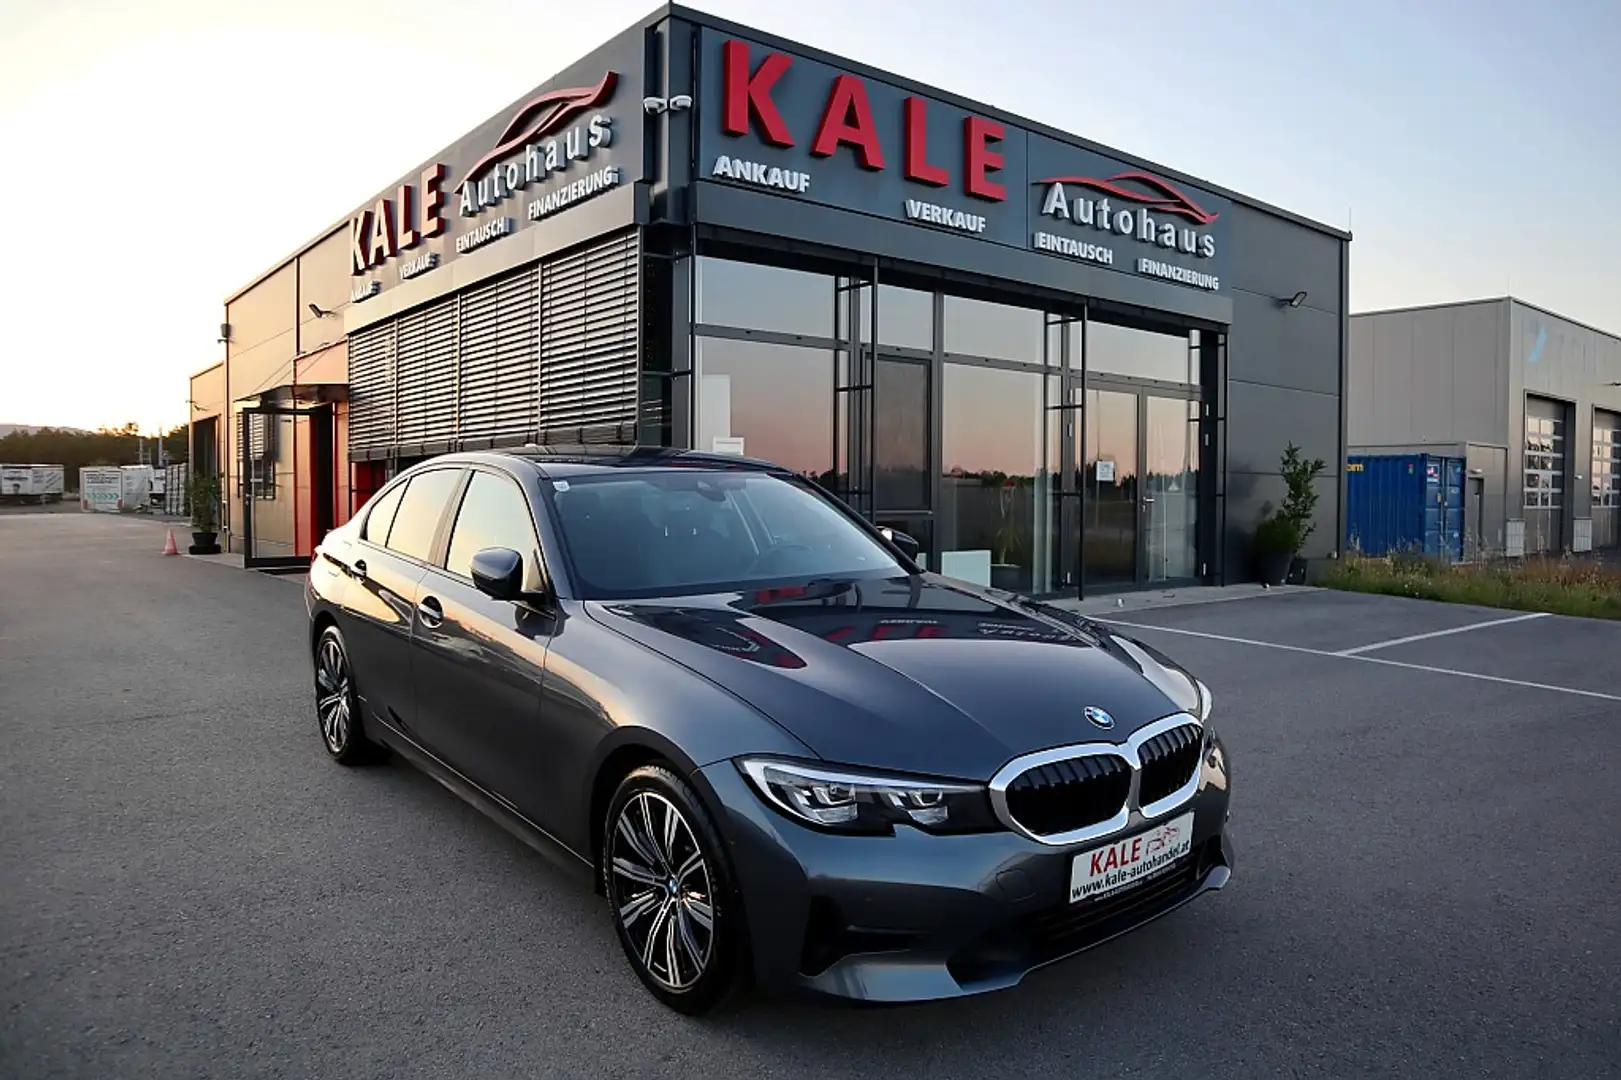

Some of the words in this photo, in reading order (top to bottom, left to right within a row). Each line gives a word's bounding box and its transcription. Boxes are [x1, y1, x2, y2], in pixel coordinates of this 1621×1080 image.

[350, 163, 446, 276] KALE
[459, 114, 613, 217] Autohaus
[456, 216, 511, 254] EINTAUSCH
[528, 165, 620, 221] FINANZIERUNG
[723, 39, 1006, 200] KALE
[1042, 182, 1216, 259] Autohaus
[712, 155, 811, 193] ANKAUF
[905, 199, 987, 233] VERKAUF
[1034, 232, 1114, 265] EINTAUSCH
[1137, 258, 1220, 291] FINANZIERUNG
[1089, 838, 1143, 877] KALE
